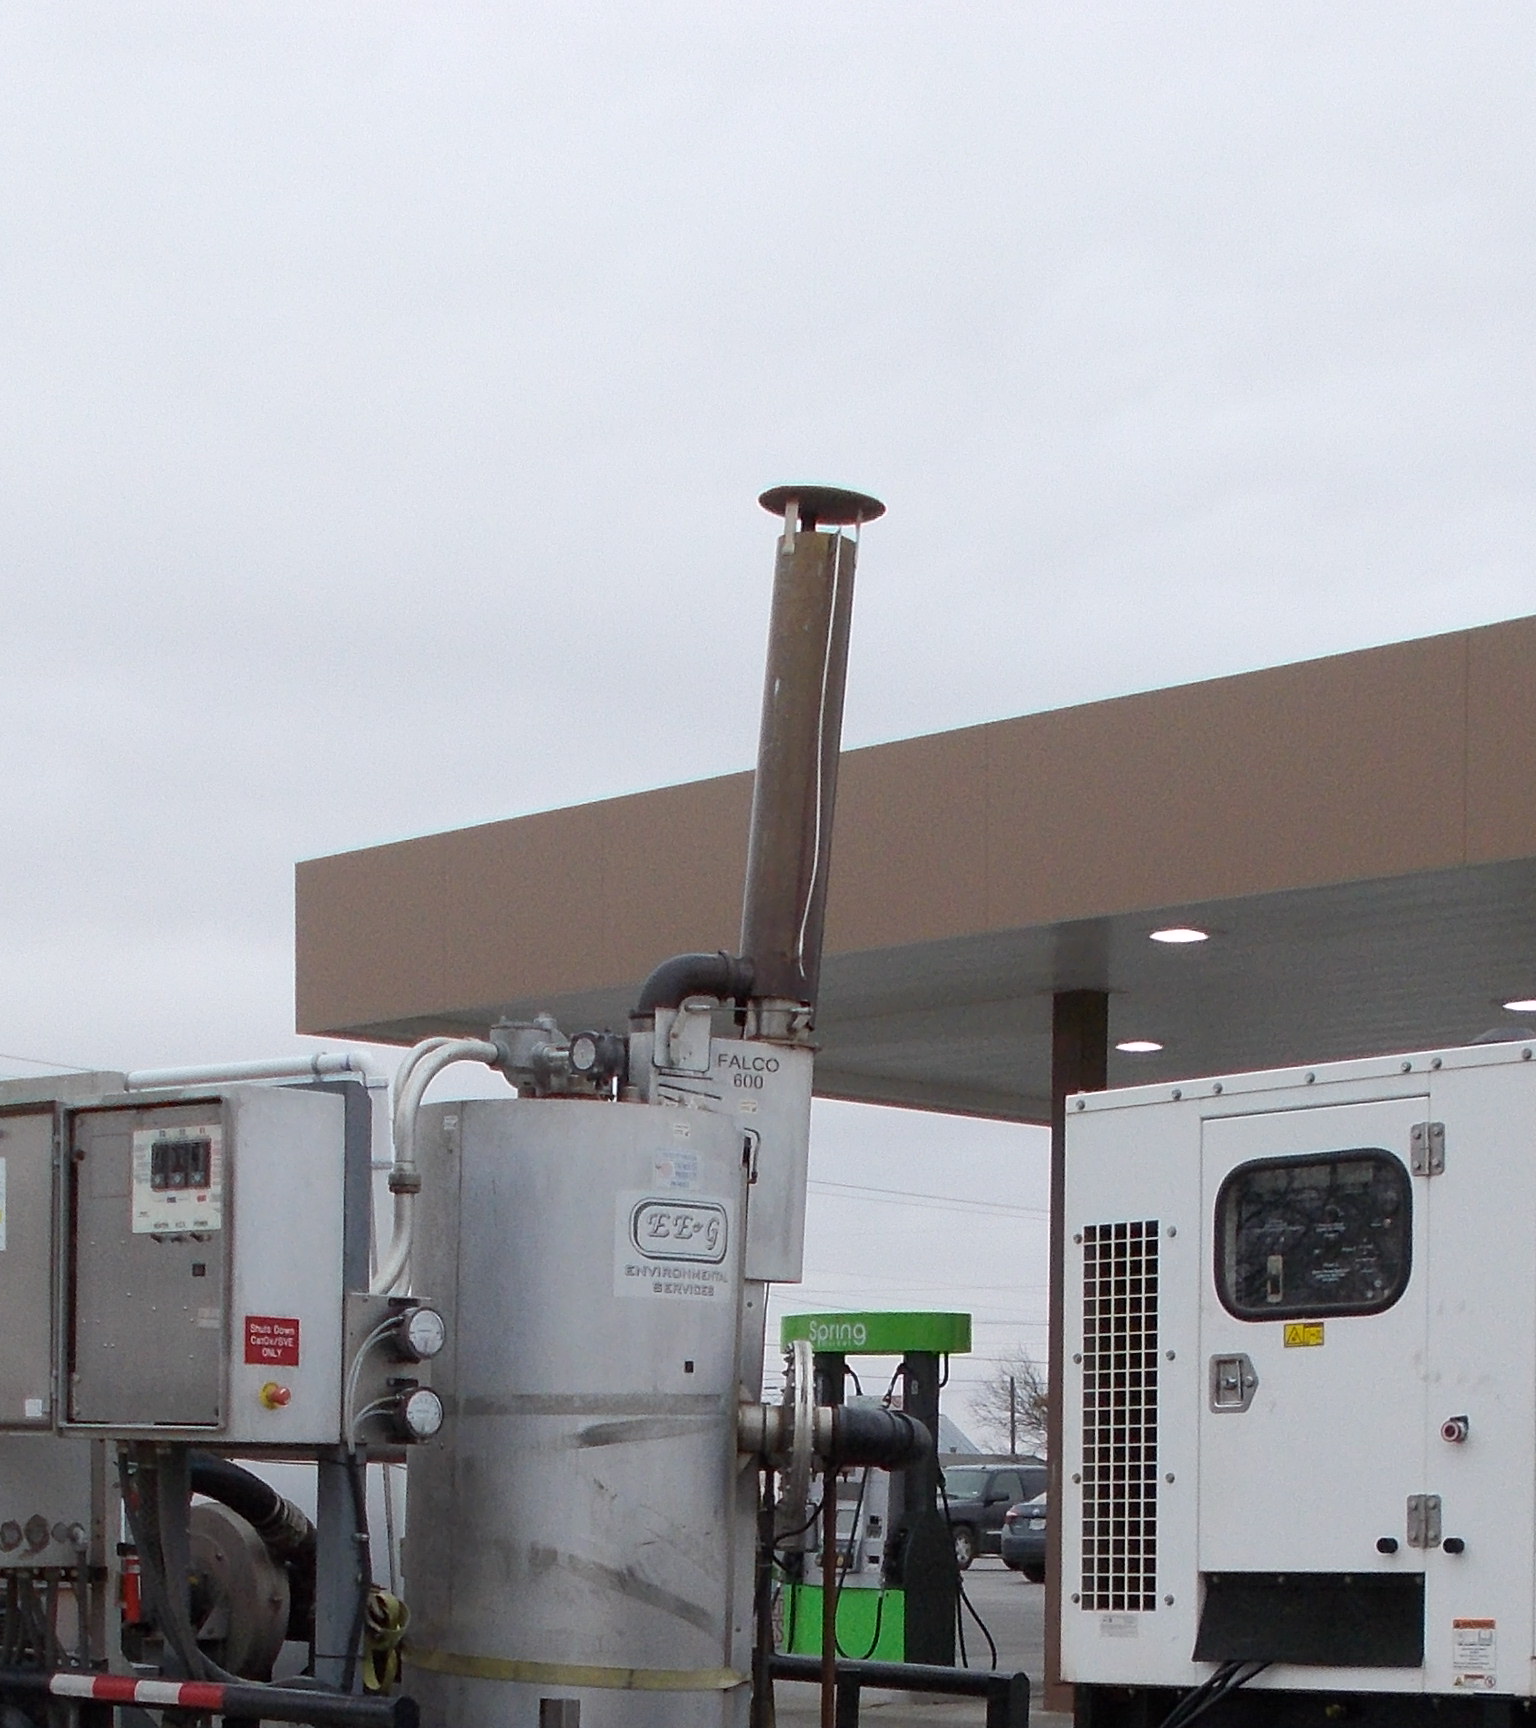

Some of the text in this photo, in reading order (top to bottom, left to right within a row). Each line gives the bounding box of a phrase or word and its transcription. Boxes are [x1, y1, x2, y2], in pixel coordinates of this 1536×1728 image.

[718, 1053, 780, 1073] FALCO
[733, 1073, 764, 1090] 600
[625, 1264, 729, 1283] ENVIRONMENTAL
[653, 1281, 715, 1297] SERVICES
[809, 1320, 867, 1346] Spring
[261, 1347, 282, 1358] ONLY
